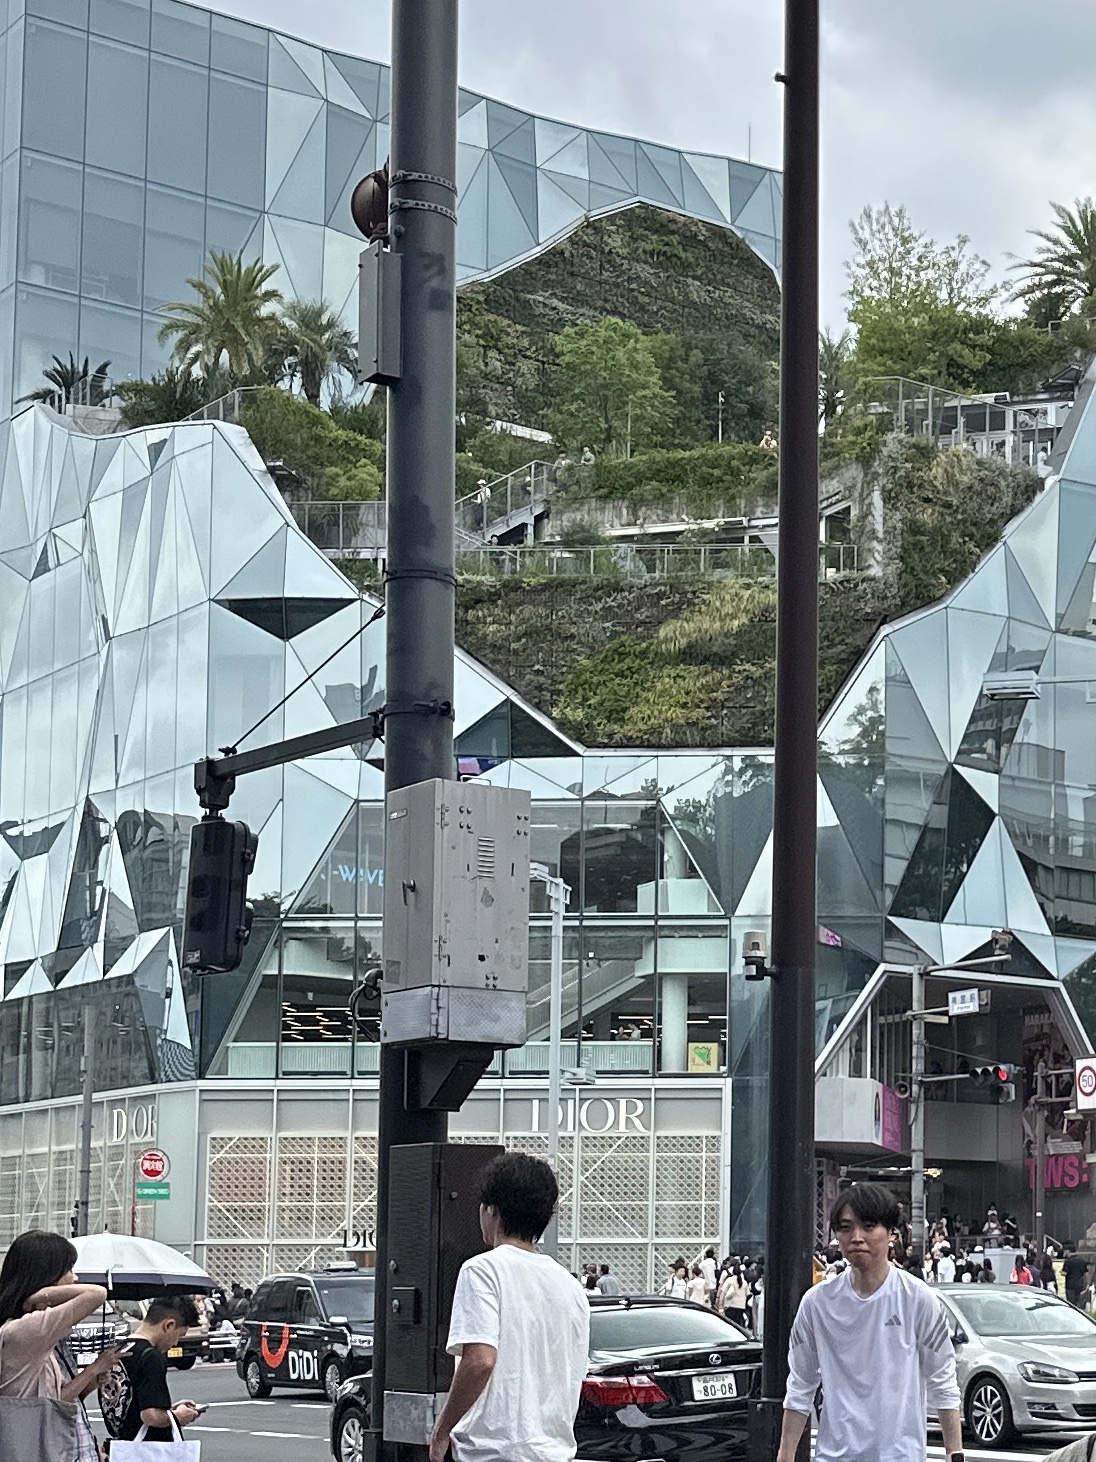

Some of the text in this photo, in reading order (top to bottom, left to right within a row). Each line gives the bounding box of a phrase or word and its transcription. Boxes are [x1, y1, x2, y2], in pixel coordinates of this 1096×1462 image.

[1082, 1075, 1094, 1088] 50
[288, 1349, 319, 1380] DiDi
[703, 1382, 734, 1397] 80-08
